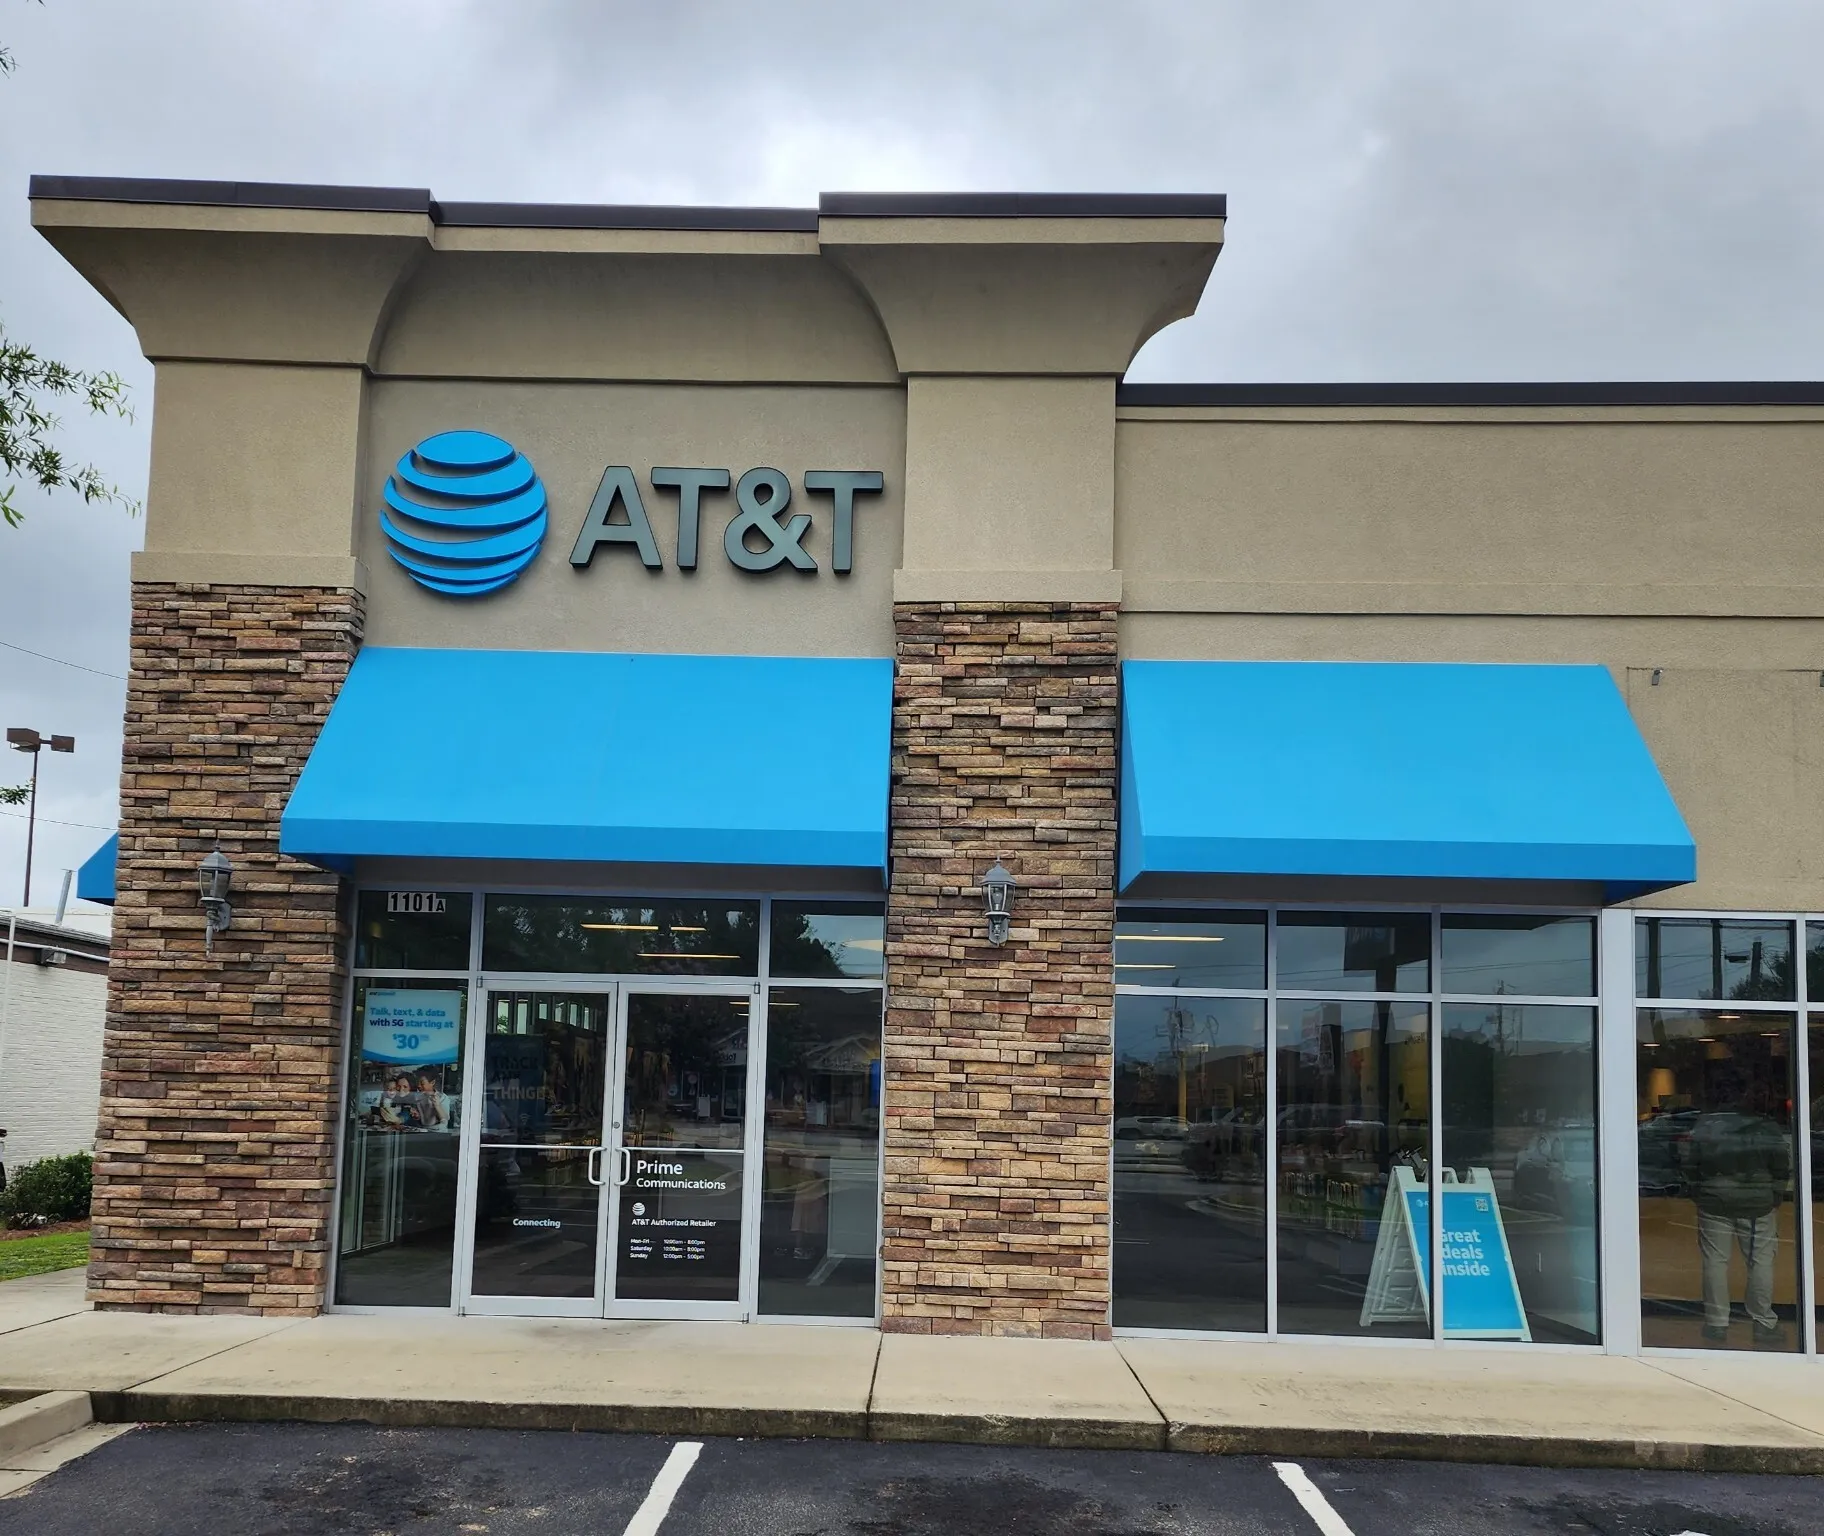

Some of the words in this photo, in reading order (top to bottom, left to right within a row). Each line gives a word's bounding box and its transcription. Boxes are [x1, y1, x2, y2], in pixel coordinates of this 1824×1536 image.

[568, 465, 884, 575] AT&T
[390, 893, 445, 911] 1101A
[370, 1007, 391, 1017] Talk,
[393, 1007, 415, 1018] text,
[416, 1008, 423, 1017] &
[425, 1008, 446, 1017] data
[369, 1018, 390, 1027] with
[391, 1019, 404, 1027] 5G
[405, 1019, 442, 1030] starting
[636, 1160, 683, 1175] Prime
[636, 1177, 727, 1190] Communications
[512, 1218, 561, 1229] Connecting
[631, 1218, 650, 1226] AT&T
[650, 1218, 688, 1226] Authorized
[690, 1219, 716, 1227] Retailer
[1442, 1244, 1484, 1260] deals
[1442, 1260, 1490, 1276] inside
